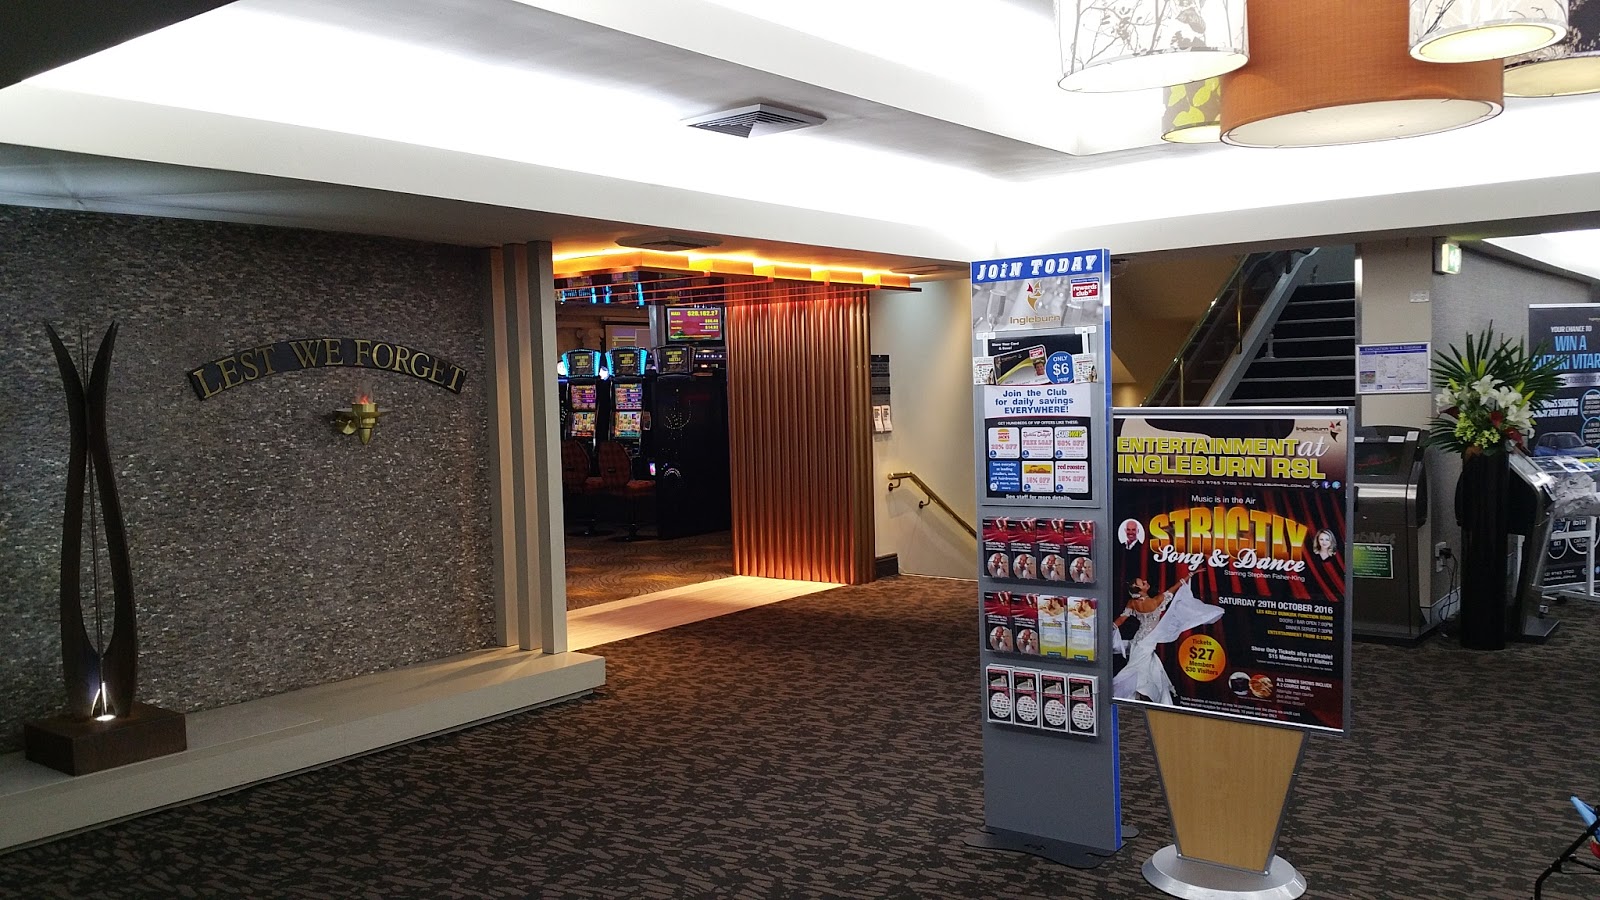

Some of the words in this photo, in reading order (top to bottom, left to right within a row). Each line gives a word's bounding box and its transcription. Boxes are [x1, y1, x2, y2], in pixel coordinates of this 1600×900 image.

[1031, 255, 1098, 275] TODAY
[1073, 283, 1098, 291] rewards
[1010, 315, 1061, 326] Ingleburn
[1555, 336, 1578, 351] WIN
[1579, 335, 1587, 351] A
[193, 344, 278, 400] LEST
[289, 338, 344, 369] WE
[354, 339, 466, 391] FORGET
[1053, 362, 1070, 376] $6
[1003, 389, 1021, 397] Join
[1027, 389, 1041, 397] the
[1046, 388, 1067, 396] Club
[995, 398, 1007, 406] for
[1012, 398, 1034, 407] daily
[1039, 397, 1074, 407] savings
[1557, 398, 1579, 407] STARTING
[1004, 406, 1069, 414] EVERYWHERE!
[1117, 436, 1299, 456] ENTERTAINMENT
[1297, 435, 1330, 458] at
[1117, 454, 1268, 479] INGLEBURN
[1271, 458, 1326, 480] RSL
[1191, 494, 1213, 503] Music
[1215, 495, 1221, 503] is
[1222, 495, 1230, 503] in
[1231, 496, 1244, 504] the
[1245, 496, 1257, 505] Air
[1149, 506, 1308, 561] STRICTLY
[1153, 544, 1205, 570] Song
[1208, 548, 1230, 568] &
[1233, 547, 1306, 573] Dance
[1224, 569, 1247, 579] Starring
[1247, 570, 1272, 581] Stephen
[1272, 571, 1306, 583] Fisher-King
[1219, 597, 1256, 608] SATURDAY
[1257, 600, 1276, 610] 29TH
[1278, 601, 1313, 613] OCTOBER
[1314, 604, 1333, 614] 2016
[1267, 629, 1302, 638] ENTERTAINMENT
[1192, 638, 1212, 646] Tickets
[1189, 645, 1215, 661] $27
[1266, 646, 1277, 654] Only
[1308, 652, 1333, 660] available!
[1189, 660, 1215, 669] Members
[1279, 654, 1302, 663] Members
[1313, 658, 1333, 666] Visitors
[1197, 667, 1219, 676] Visitors
[1315, 681, 1333, 689] INCLUDE
